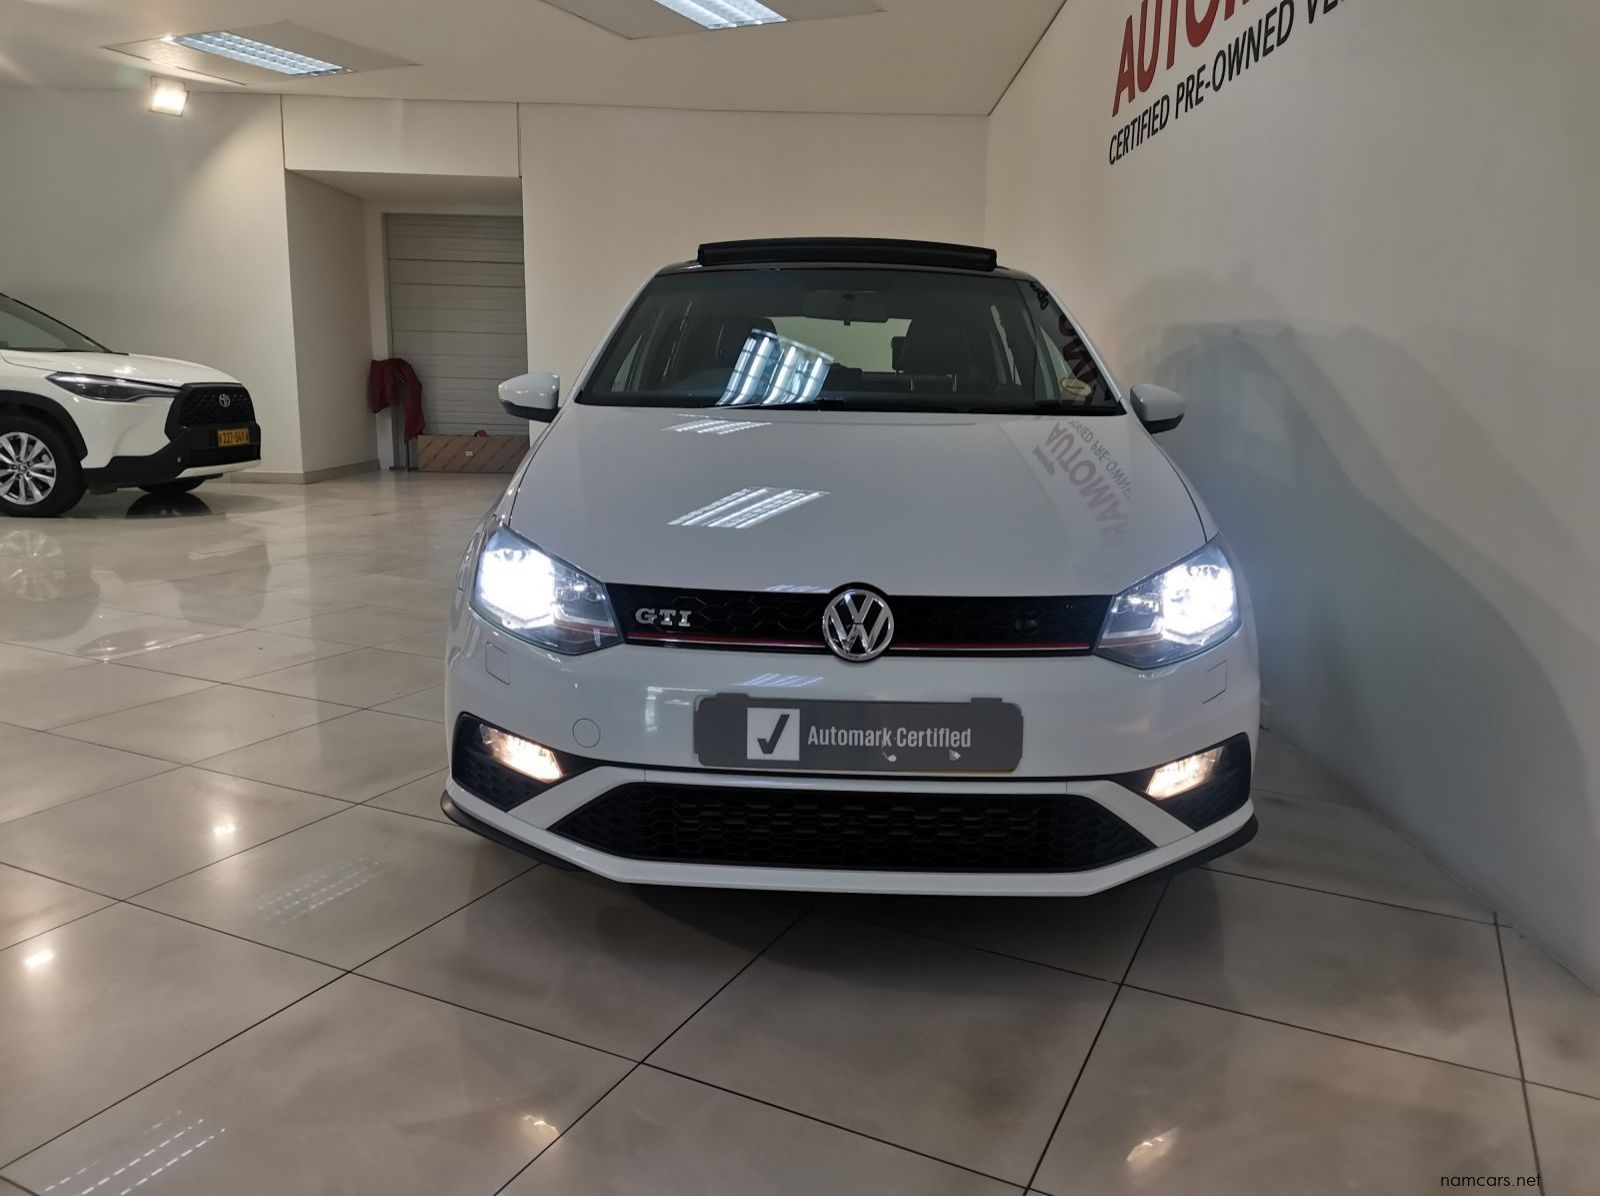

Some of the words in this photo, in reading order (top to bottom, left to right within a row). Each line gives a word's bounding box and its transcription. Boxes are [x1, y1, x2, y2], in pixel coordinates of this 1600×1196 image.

[1109, 94, 1170, 165] CERTIFIED
[1175, 0, 1294, 119] PRE-OWNED
[1112, 0, 1250, 117] AUT
[635, 607, 692, 627] GTI
[807, 725, 891, 748] Automark
[896, 727, 971, 748] Certified
